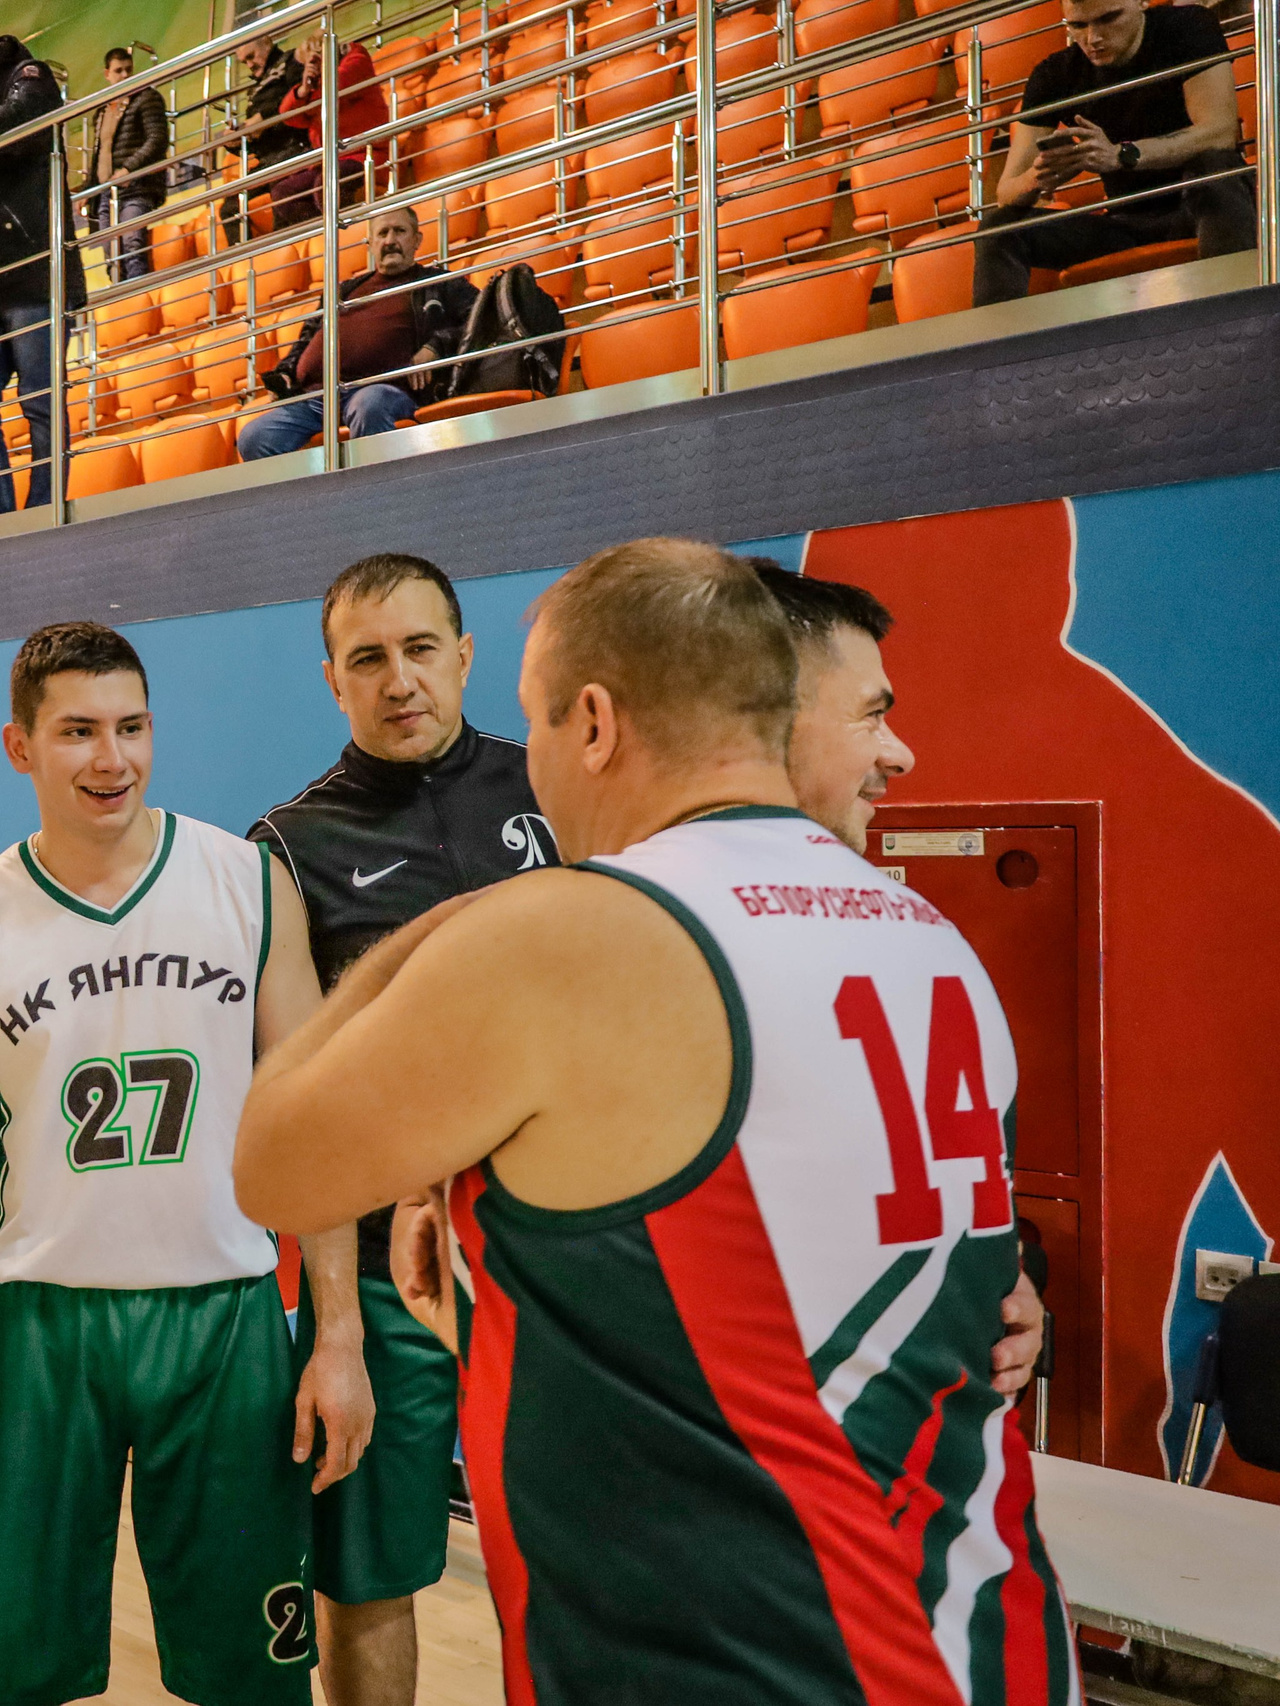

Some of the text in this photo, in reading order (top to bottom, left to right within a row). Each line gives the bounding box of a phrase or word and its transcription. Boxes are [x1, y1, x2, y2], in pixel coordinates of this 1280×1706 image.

[0, 953, 247, 1046] НК ЯНГПУР
[61, 1049, 200, 1173] 27
[833, 975, 1012, 1246] 14
